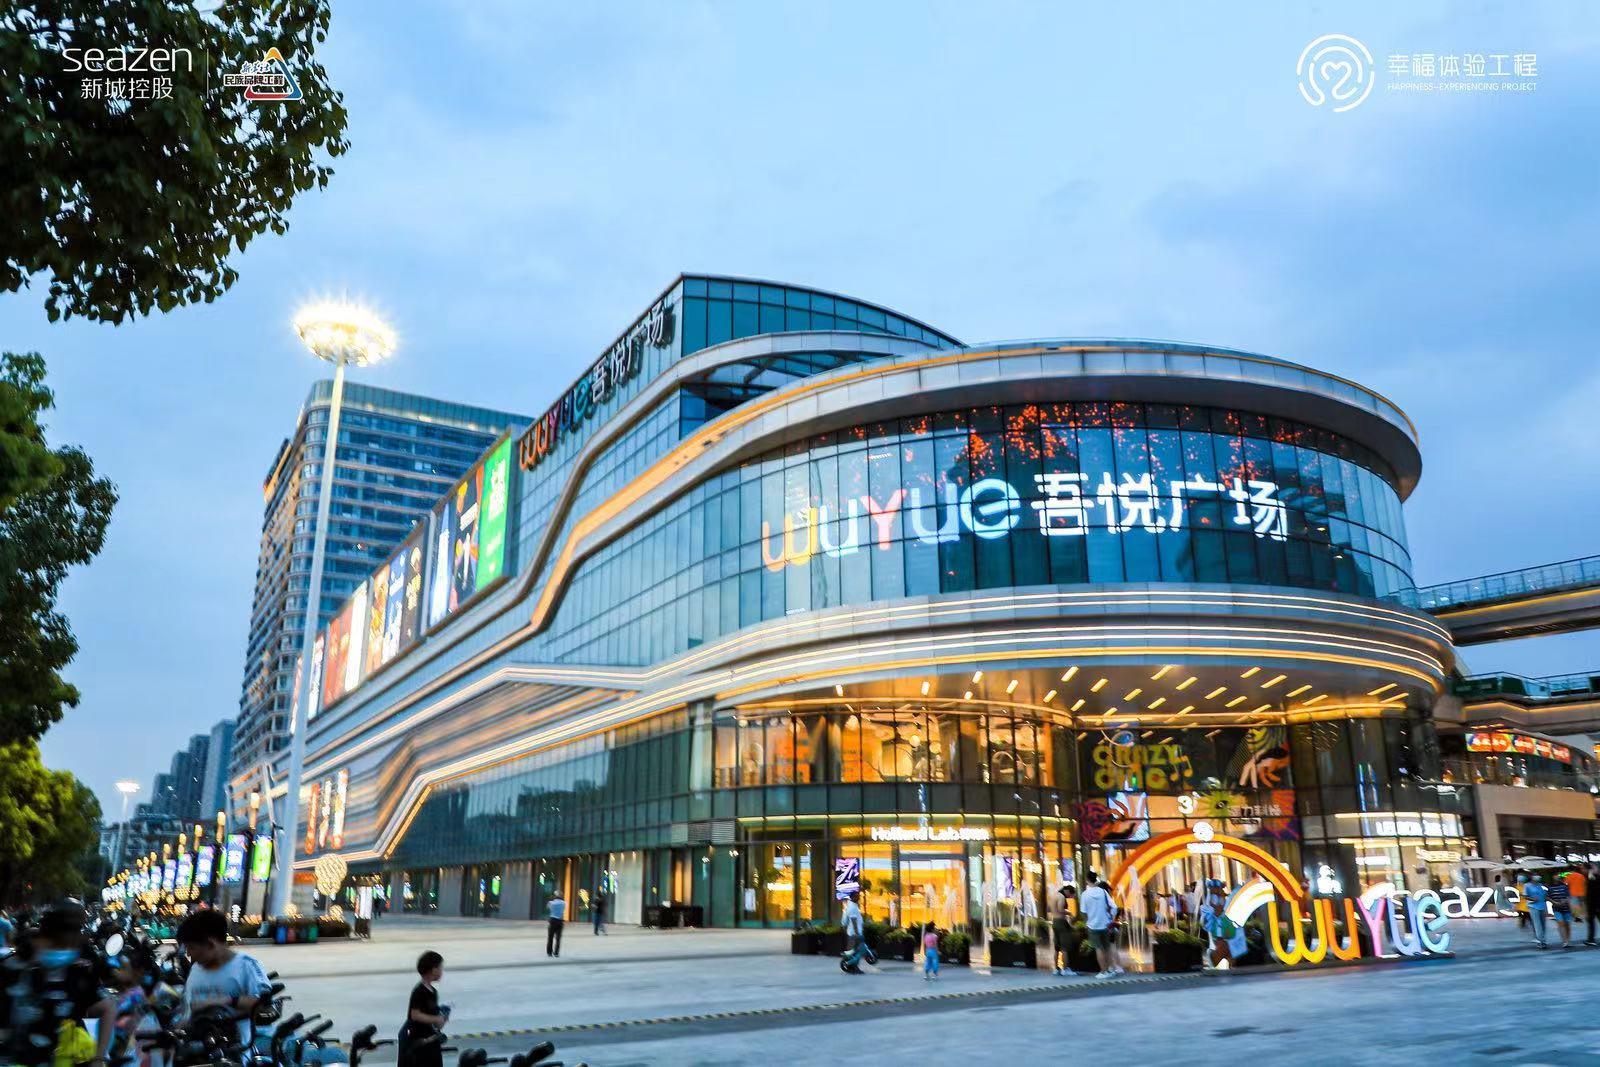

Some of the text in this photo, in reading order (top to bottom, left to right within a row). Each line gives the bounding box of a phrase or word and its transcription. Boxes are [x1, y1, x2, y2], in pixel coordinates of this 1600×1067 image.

[592, 300, 668, 404] 吾悦广场
[1031, 472, 1288, 542] 吾悦广场
